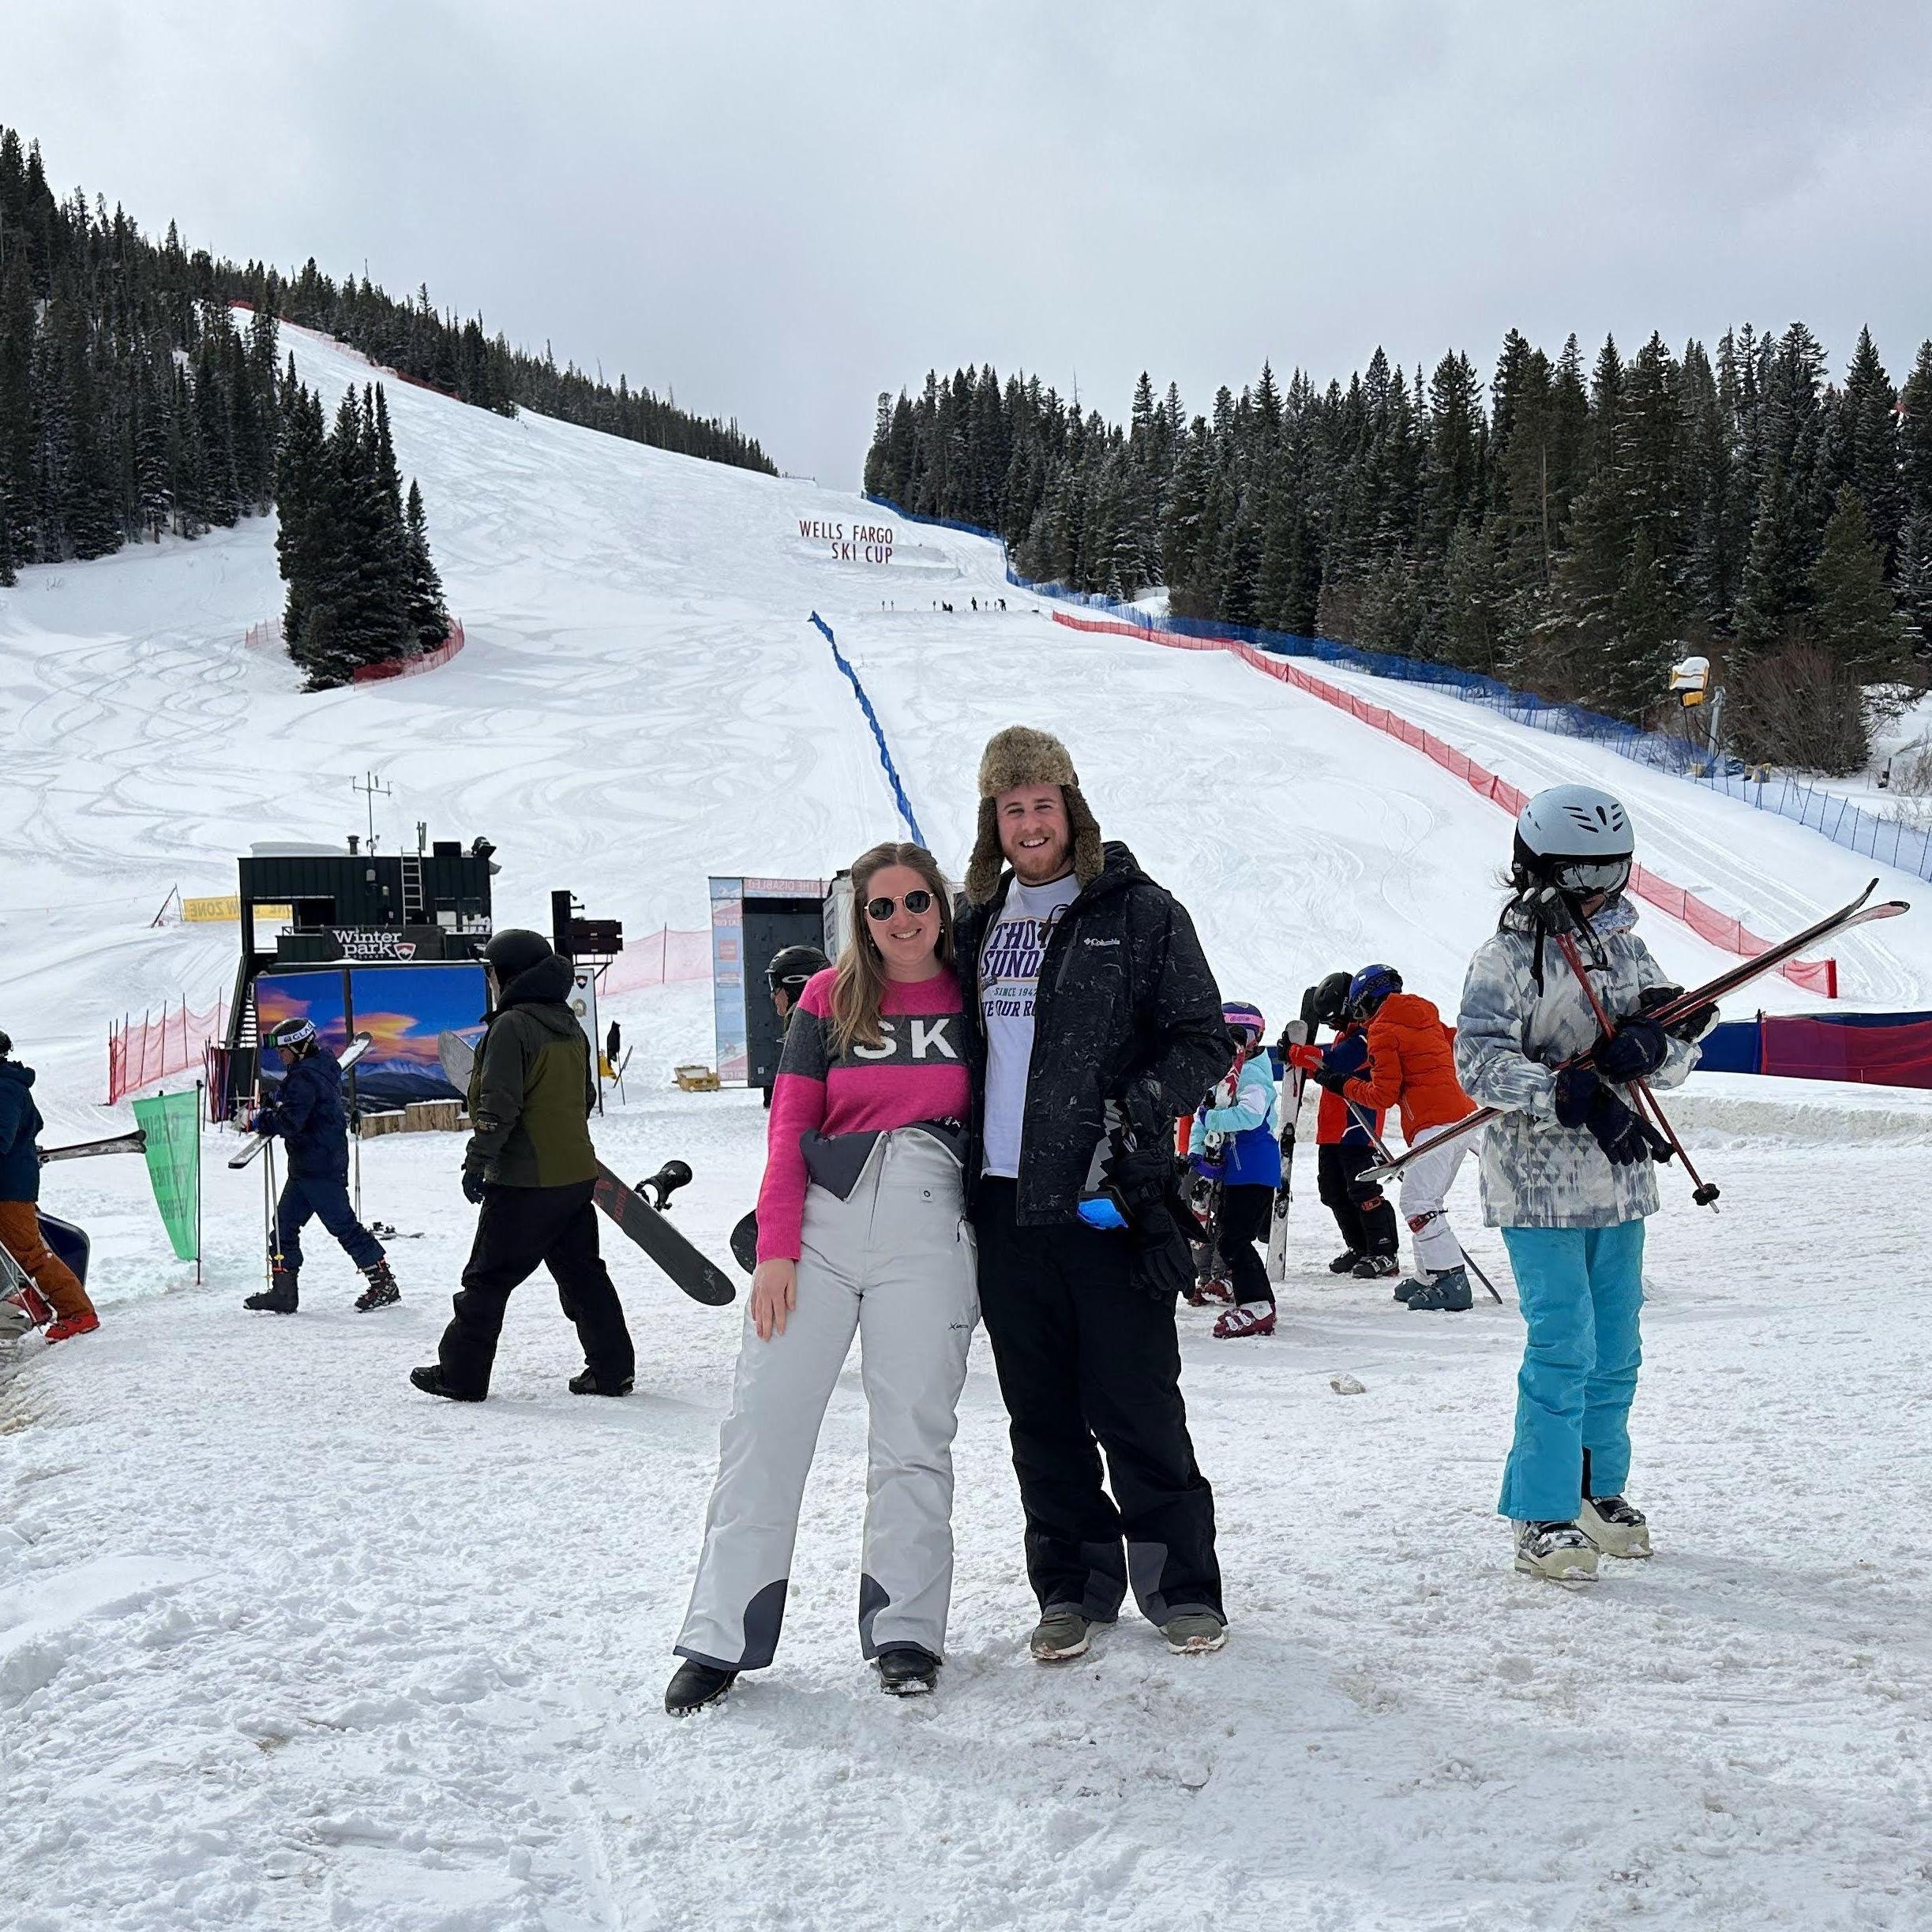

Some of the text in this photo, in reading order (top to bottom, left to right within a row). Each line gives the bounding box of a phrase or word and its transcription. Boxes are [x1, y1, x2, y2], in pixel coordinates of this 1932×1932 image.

[799, 520, 893, 544] WELLS FARGO
[831, 542, 893, 565] SKI CUP
[332, 927, 402, 943] Winter
[343, 940, 396, 958] park
[981, 950, 1041, 978] SUND
[994, 987, 1016, 996] SINCE
[996, 1000, 1020, 1017] OUR
